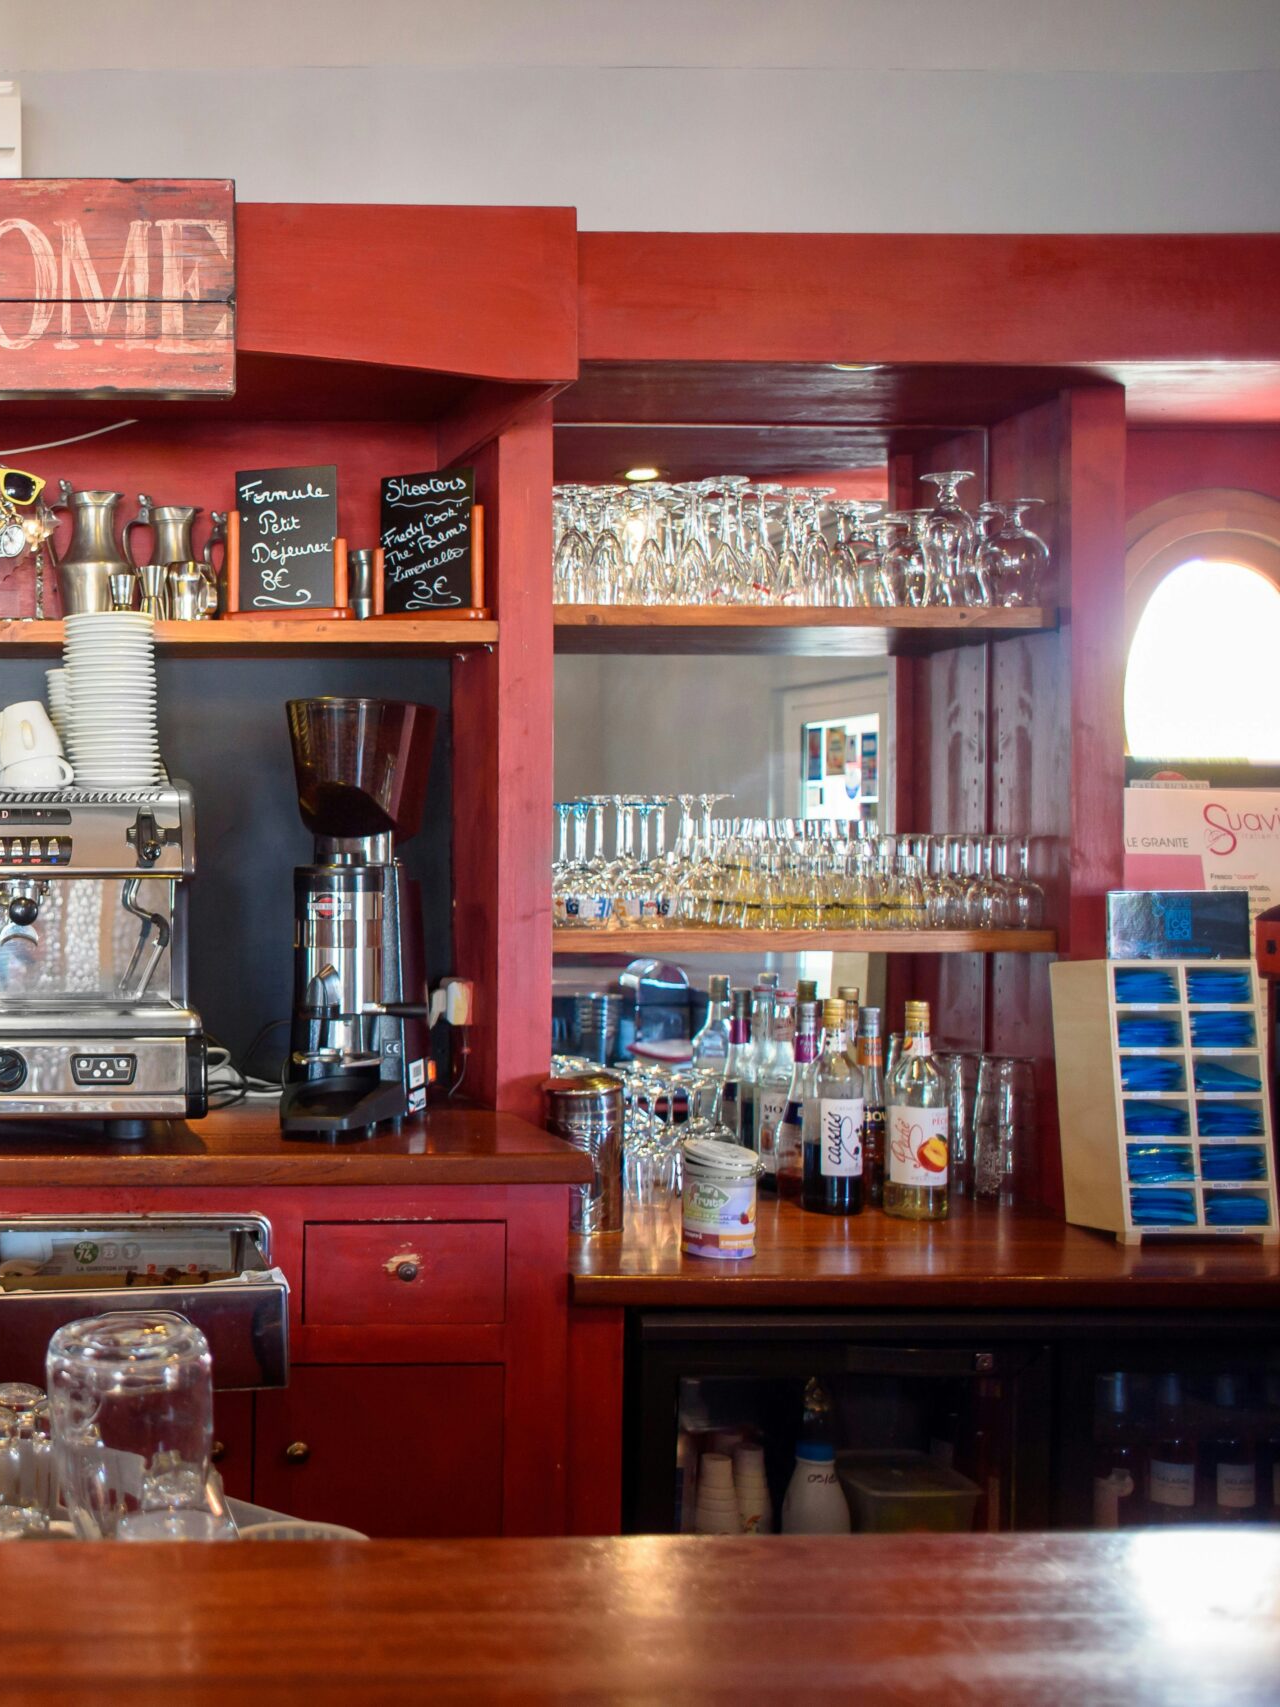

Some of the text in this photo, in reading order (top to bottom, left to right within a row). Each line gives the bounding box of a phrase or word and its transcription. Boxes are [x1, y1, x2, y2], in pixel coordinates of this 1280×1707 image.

[239, 479, 330, 504] Formule
[386, 478, 466, 501] Shooters
[258, 510, 301, 534] Petit
[384, 521, 424, 548] Fredy
[385, 550, 413, 565] The
[389, 547, 468, 582] Limoncello
[261, 568, 291, 591] 8€
[413, 576, 451, 599] 3€
[1126, 837, 1189, 848] LE GRANITE
[823, 1111, 842, 1165] cassis
[76, 1249, 92, 1260] 74
